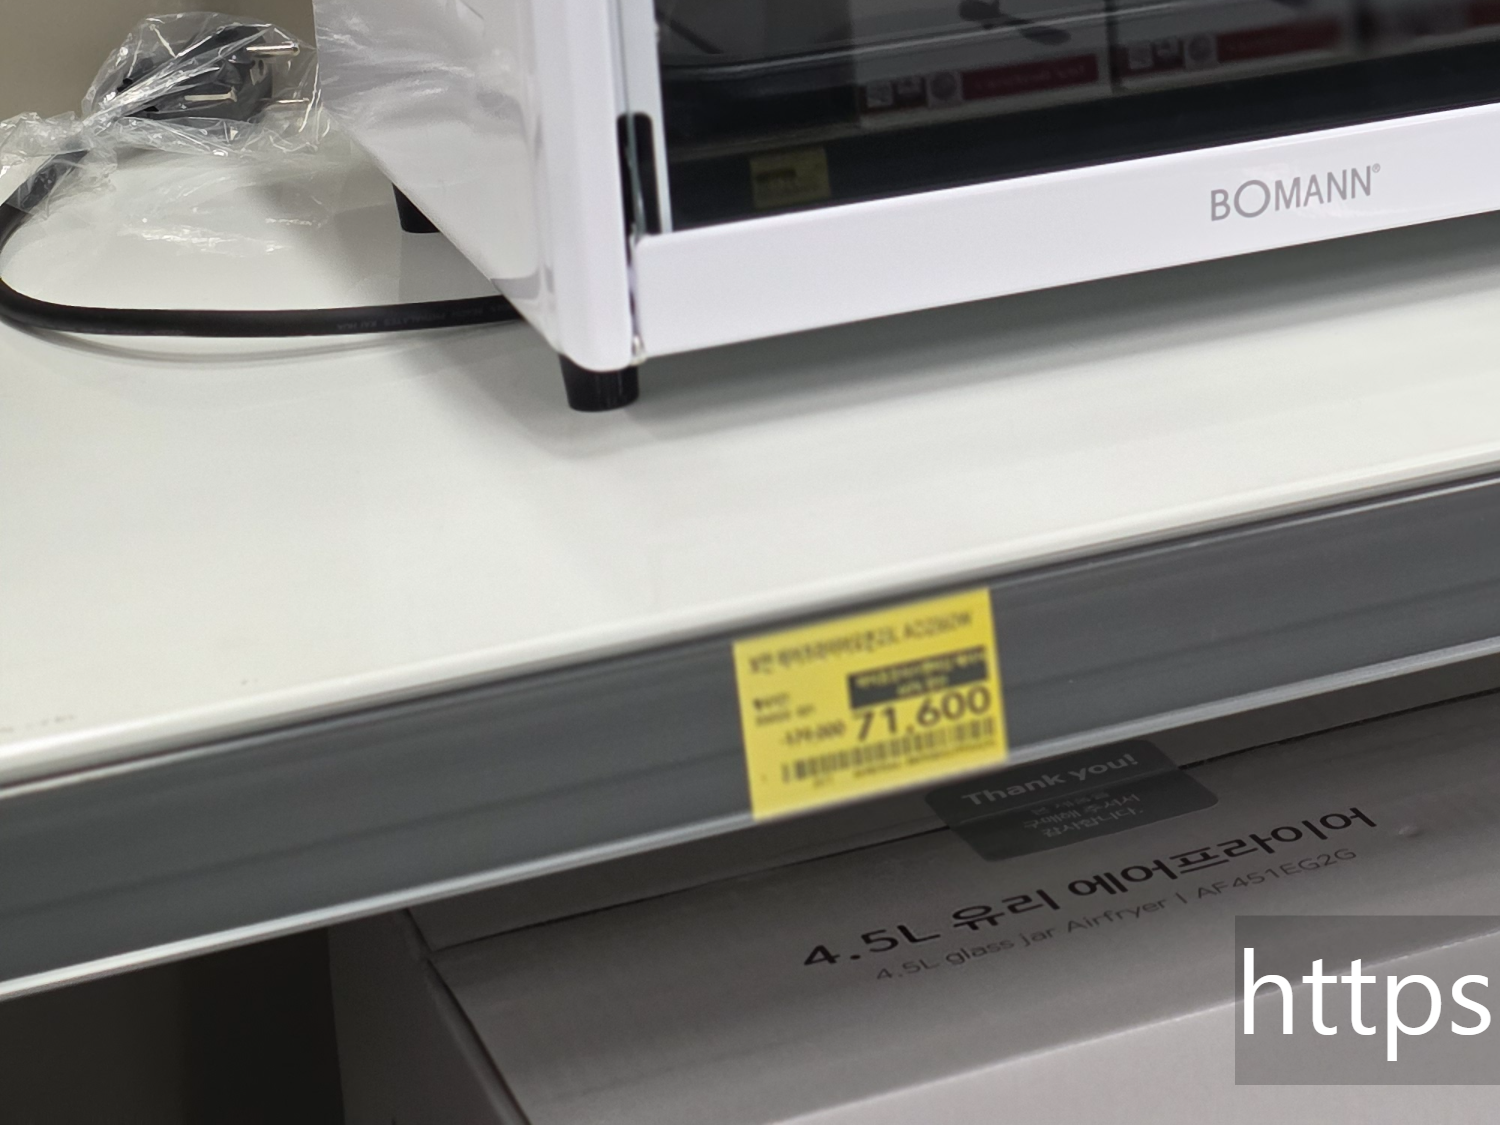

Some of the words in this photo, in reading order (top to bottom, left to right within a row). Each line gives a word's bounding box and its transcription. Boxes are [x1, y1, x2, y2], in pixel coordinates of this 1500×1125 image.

[961, 773, 1066, 806] Thank
[1067, 753, 1139, 781] you!
[803, 924, 941, 966] 4.5L
[952, 889, 1061, 931] 유리
[1067, 807, 1378, 896] 에어프라이어
[876, 959, 940, 980] 4.5L
[945, 938, 1015, 967] glass
[1020, 927, 1055, 947] jar
[1066, 898, 1168, 933] Airfryer
[1197, 848, 1357, 899] AF451EG2G
